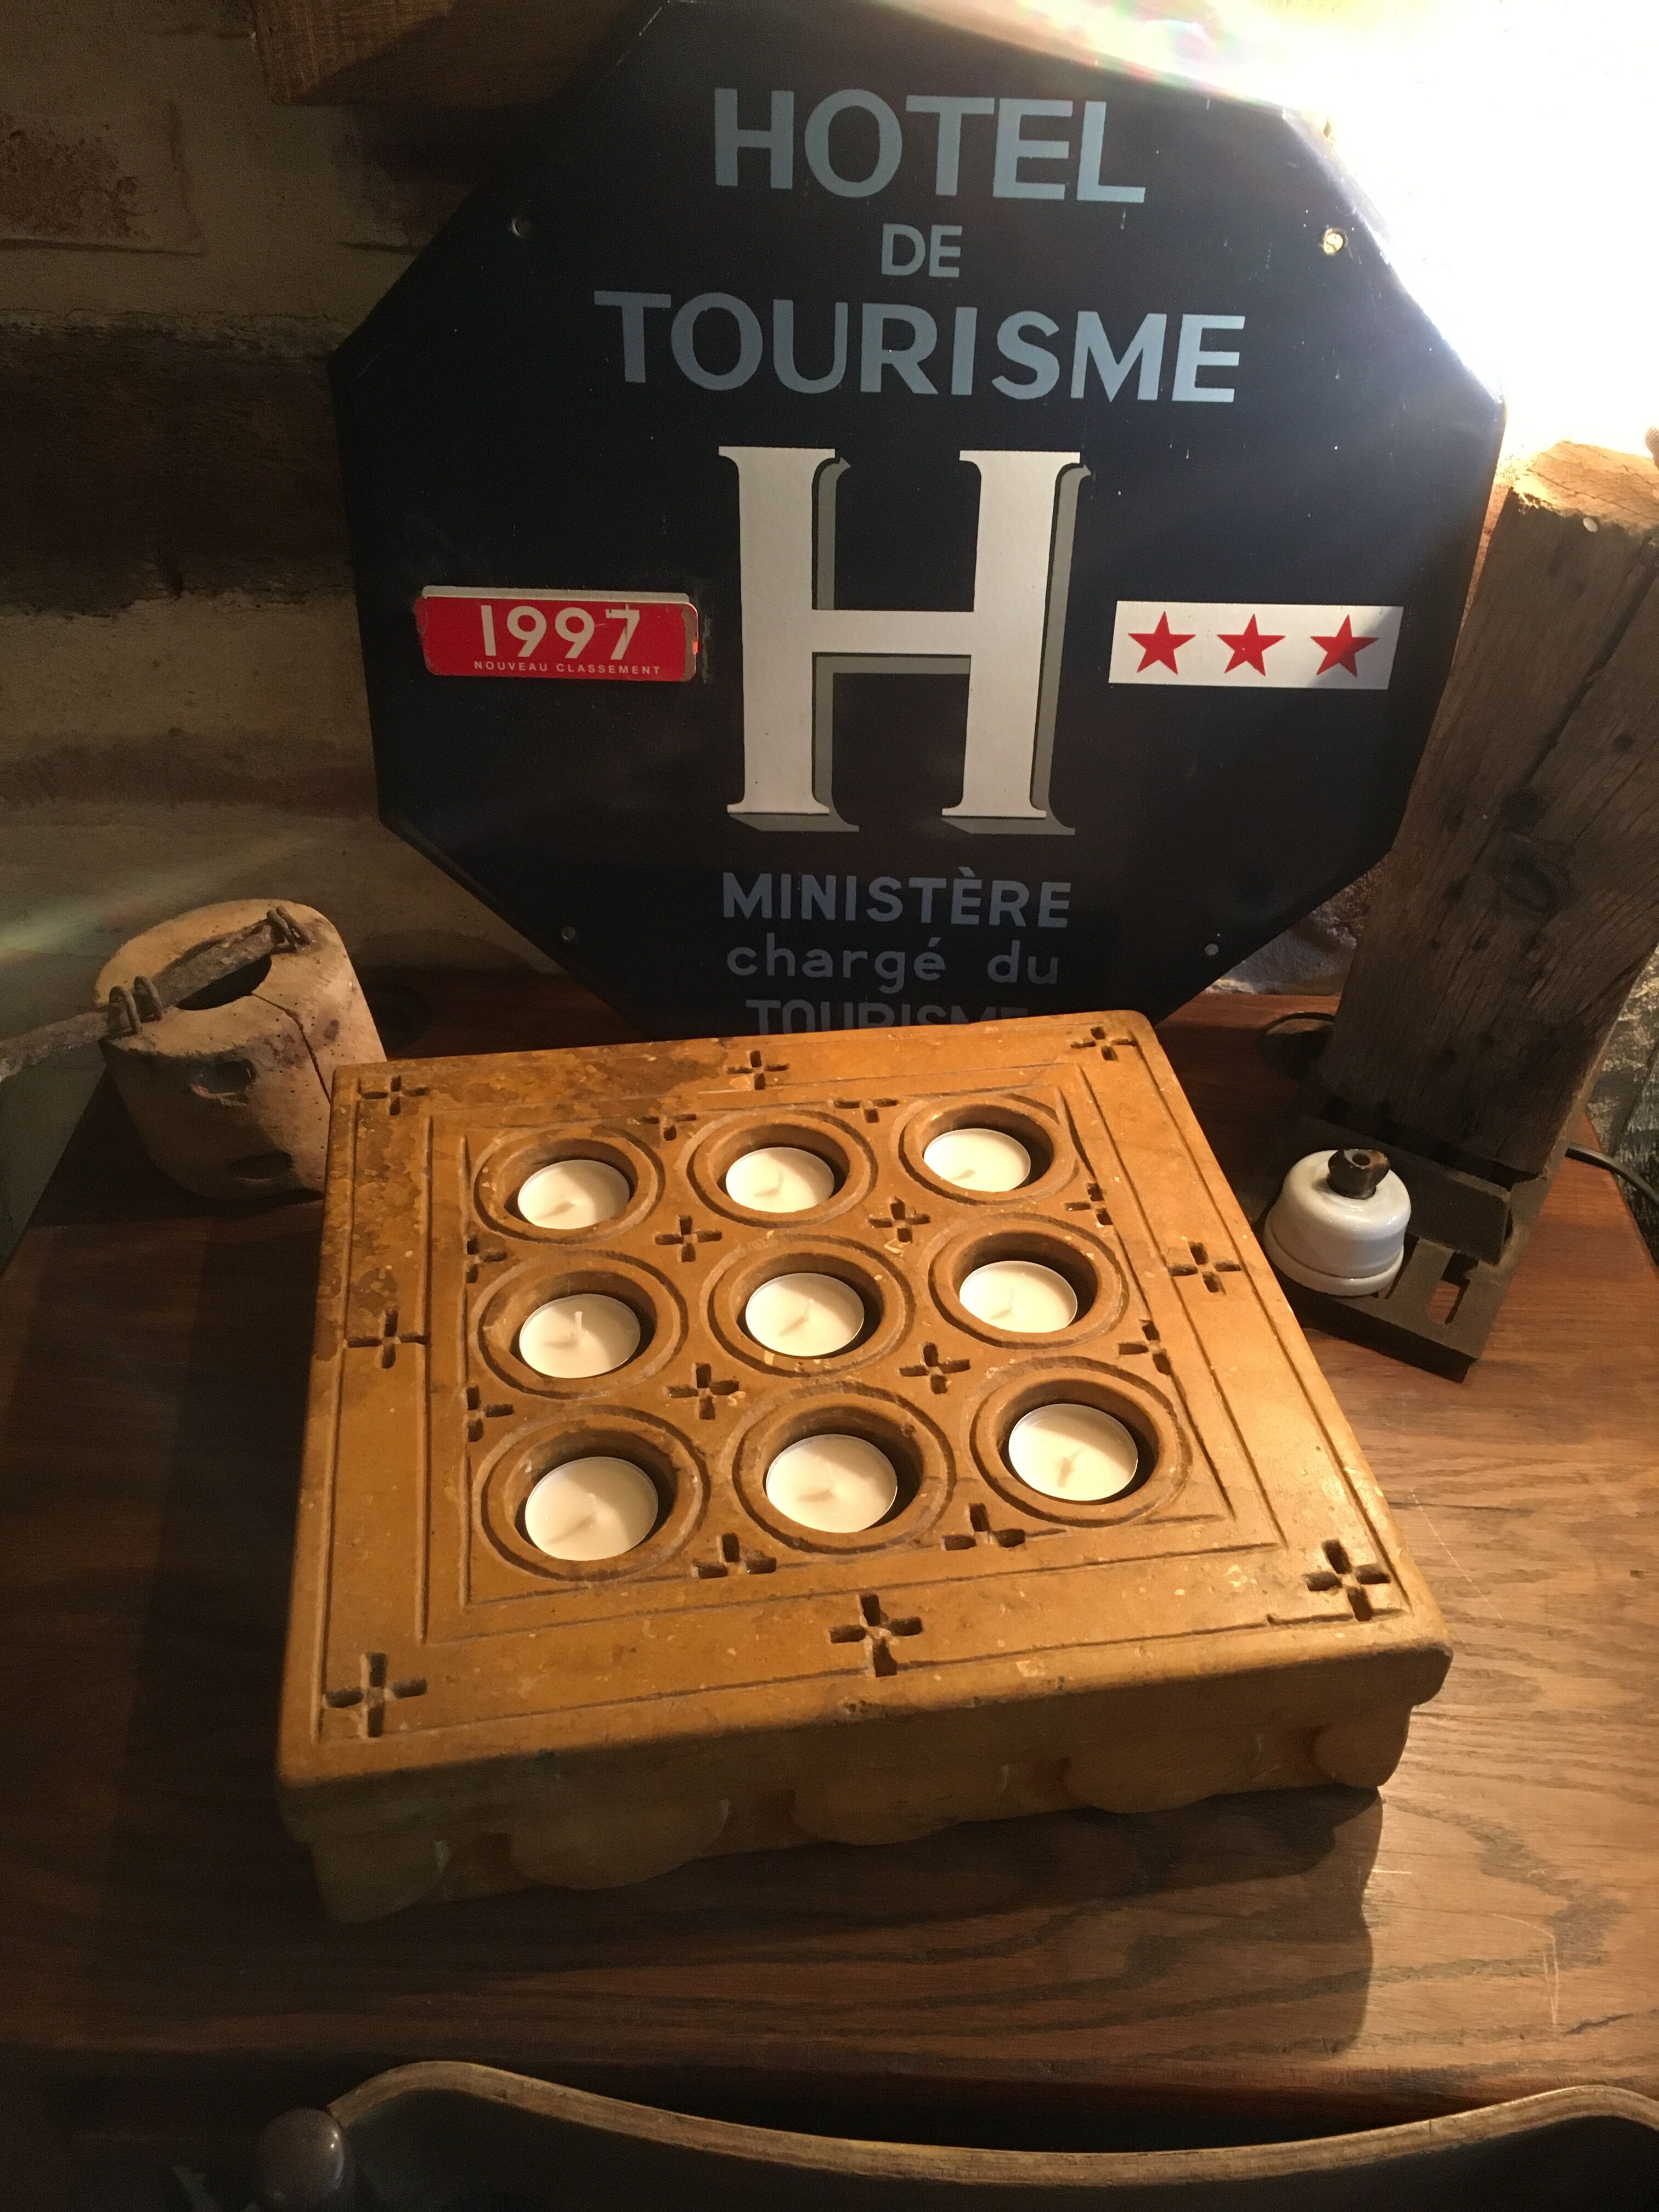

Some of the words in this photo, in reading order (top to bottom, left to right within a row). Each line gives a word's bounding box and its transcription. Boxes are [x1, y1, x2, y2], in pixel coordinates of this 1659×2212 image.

[714, 88, 1146, 204] HOTEL
[881, 223, 963, 278] DE
[594, 290, 1245, 403] TOURISME
[481, 605, 640, 661] 1997
[719, 446, 1091, 836] H
[474, 661, 548, 672] NOUVEAU
[556, 663, 661, 675] CLASSEMENT
[722, 866, 1071, 928] MINISTÈRE
[727, 933, 946, 994] chargé
[988, 940, 1059, 985] du
[746, 999, 1028, 1036] TOURI
